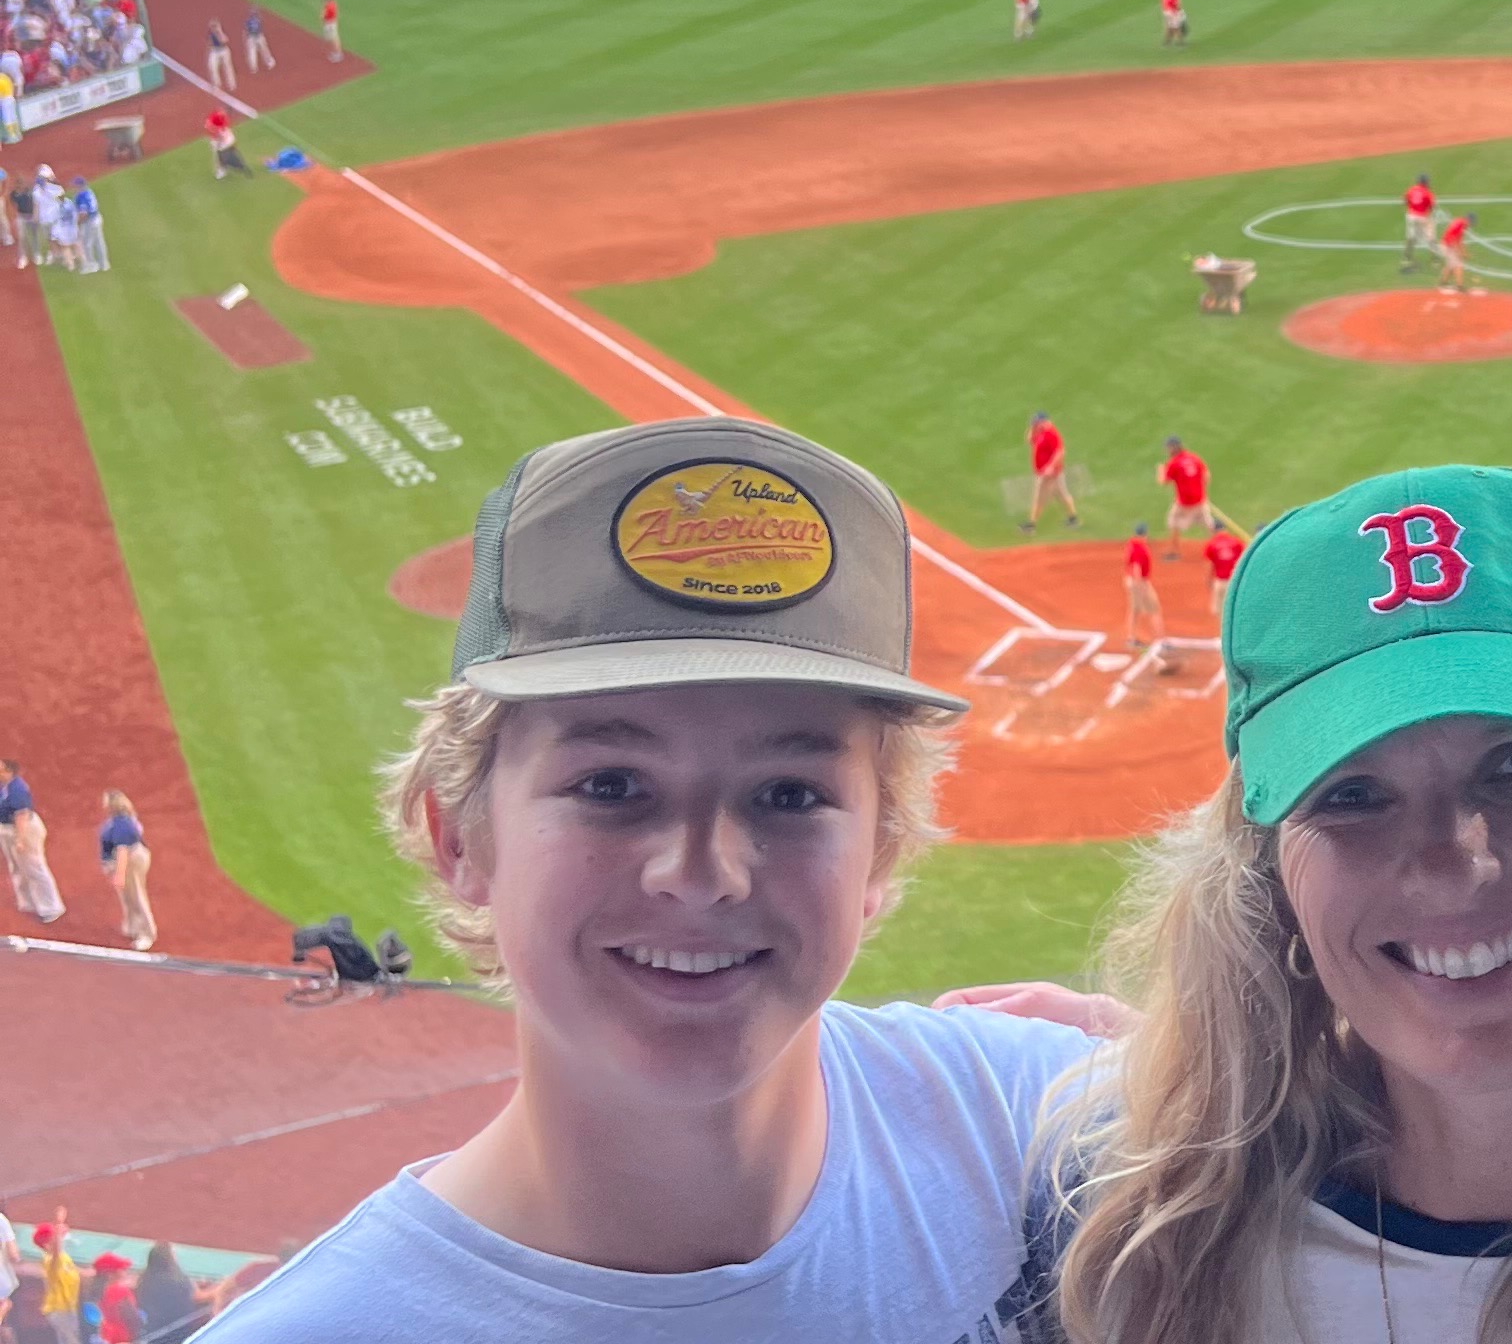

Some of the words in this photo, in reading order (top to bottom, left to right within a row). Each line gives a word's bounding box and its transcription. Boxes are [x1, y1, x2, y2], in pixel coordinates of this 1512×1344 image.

[731, 479, 801, 504] Upland
[627, 508, 825, 553] American
[1358, 504, 1475, 614] B
[742, 581, 782, 596] 2018
